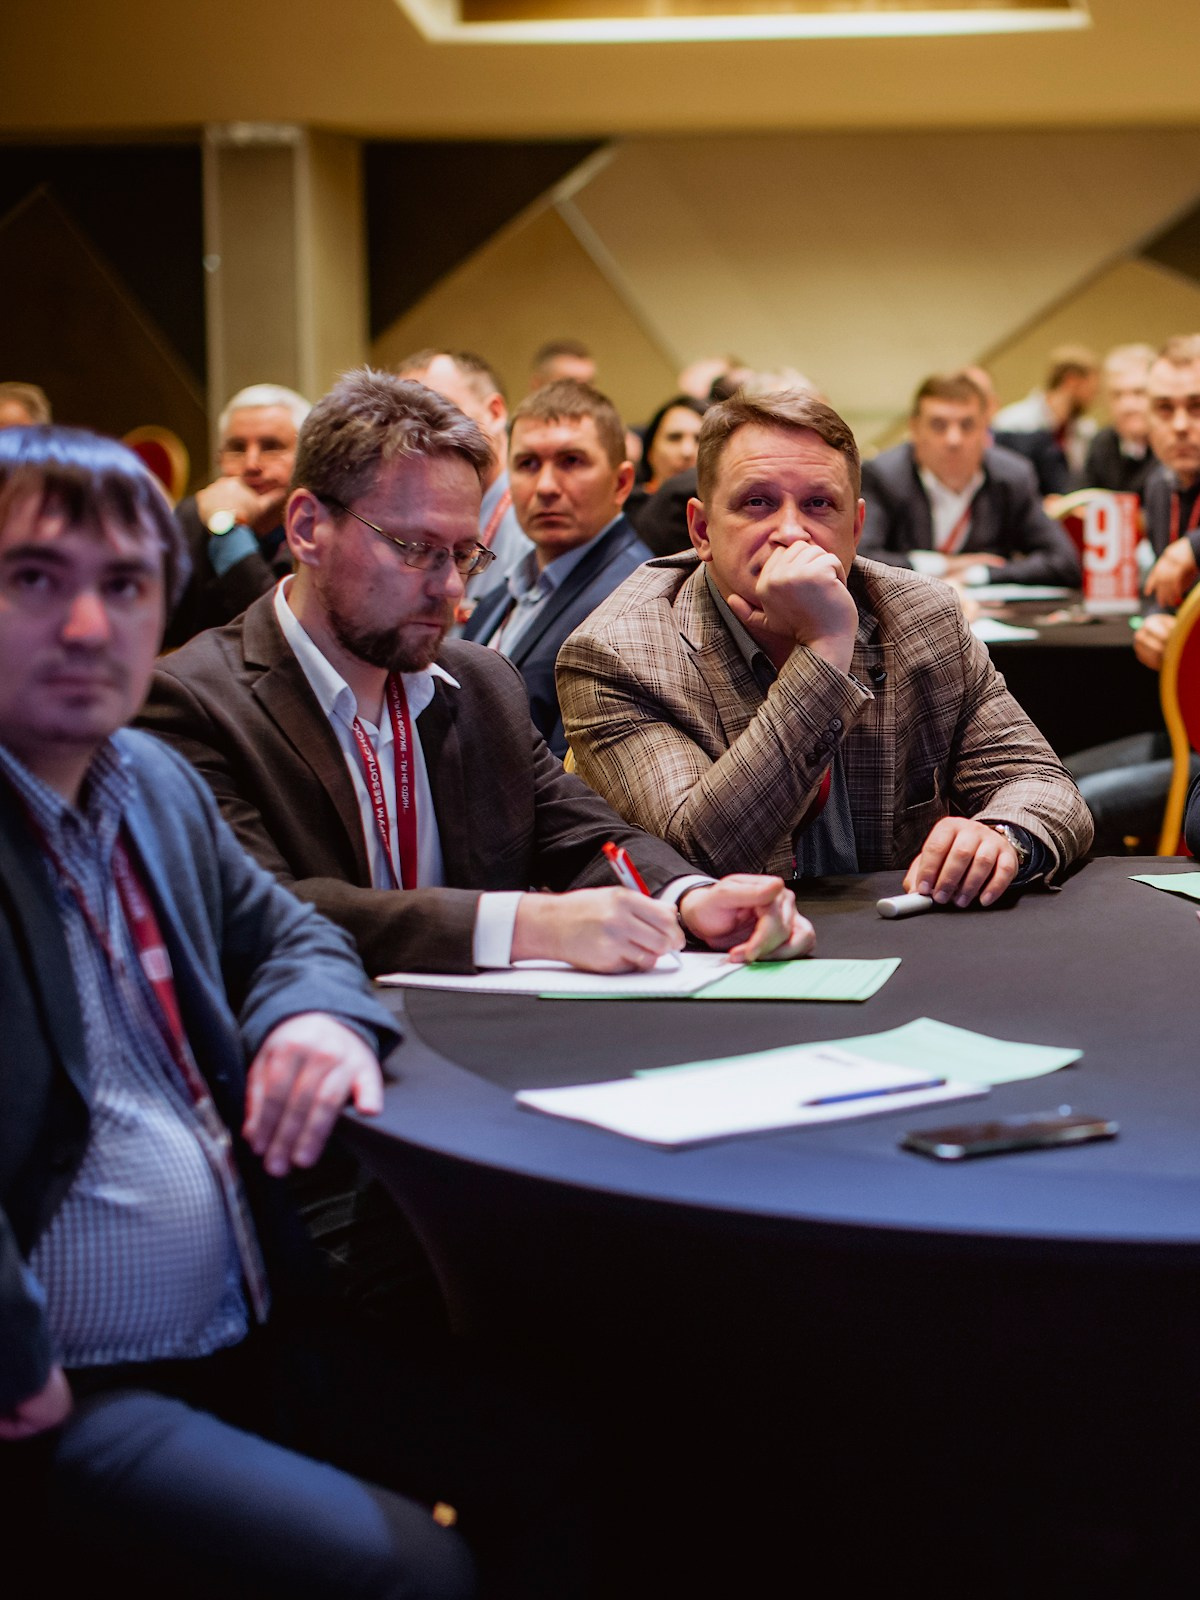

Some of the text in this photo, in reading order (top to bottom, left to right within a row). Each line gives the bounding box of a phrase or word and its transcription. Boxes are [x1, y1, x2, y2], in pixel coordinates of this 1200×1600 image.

[1083, 495, 1120, 572] 9
[397, 719, 408, 752] ФОРУМЕ
[351, 723, 383, 804] БЕЗОПАСНОС
[400, 760, 408, 771] ТЫ
[401, 773, 409, 783] НЕ
